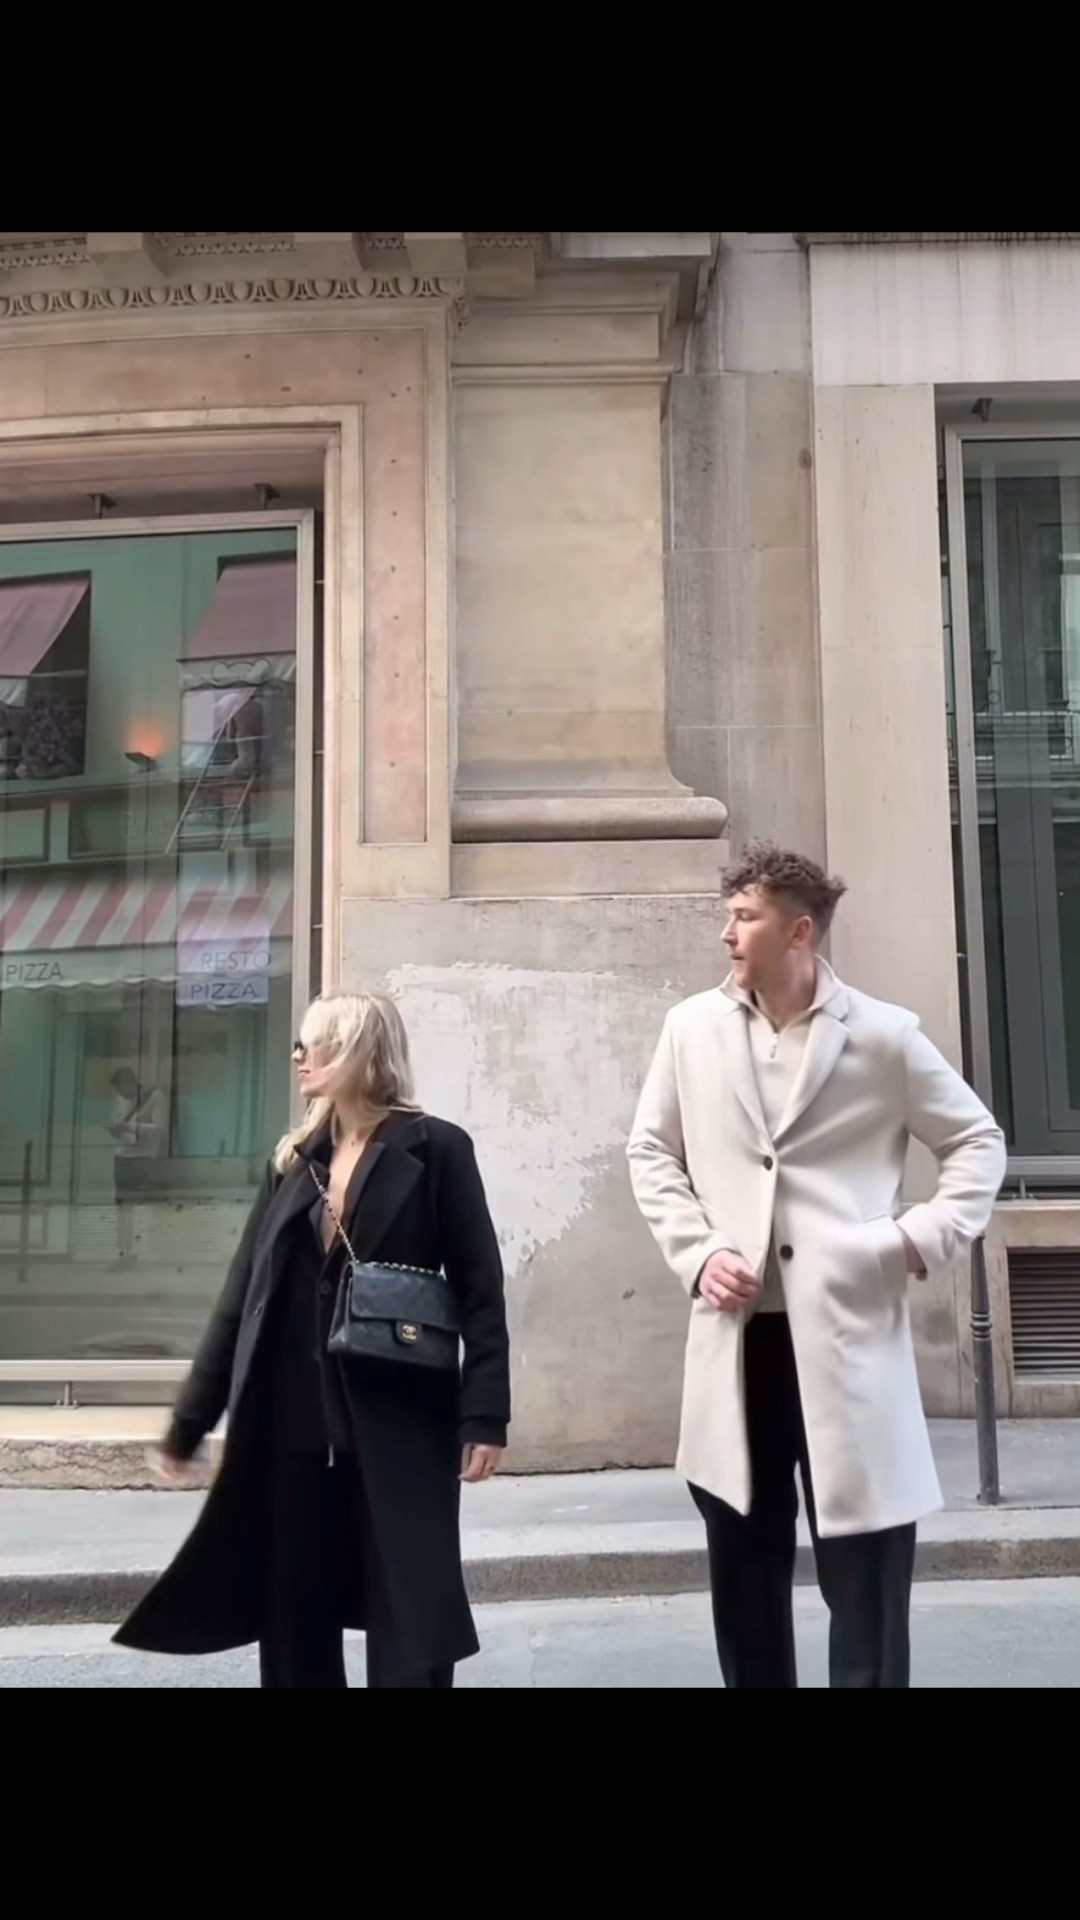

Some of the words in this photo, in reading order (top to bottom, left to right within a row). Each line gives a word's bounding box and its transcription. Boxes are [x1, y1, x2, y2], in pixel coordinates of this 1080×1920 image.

[202, 952, 272, 972] RESTO
[6, 963, 63, 982] PIZZA
[191, 982, 257, 999] PIZZA
